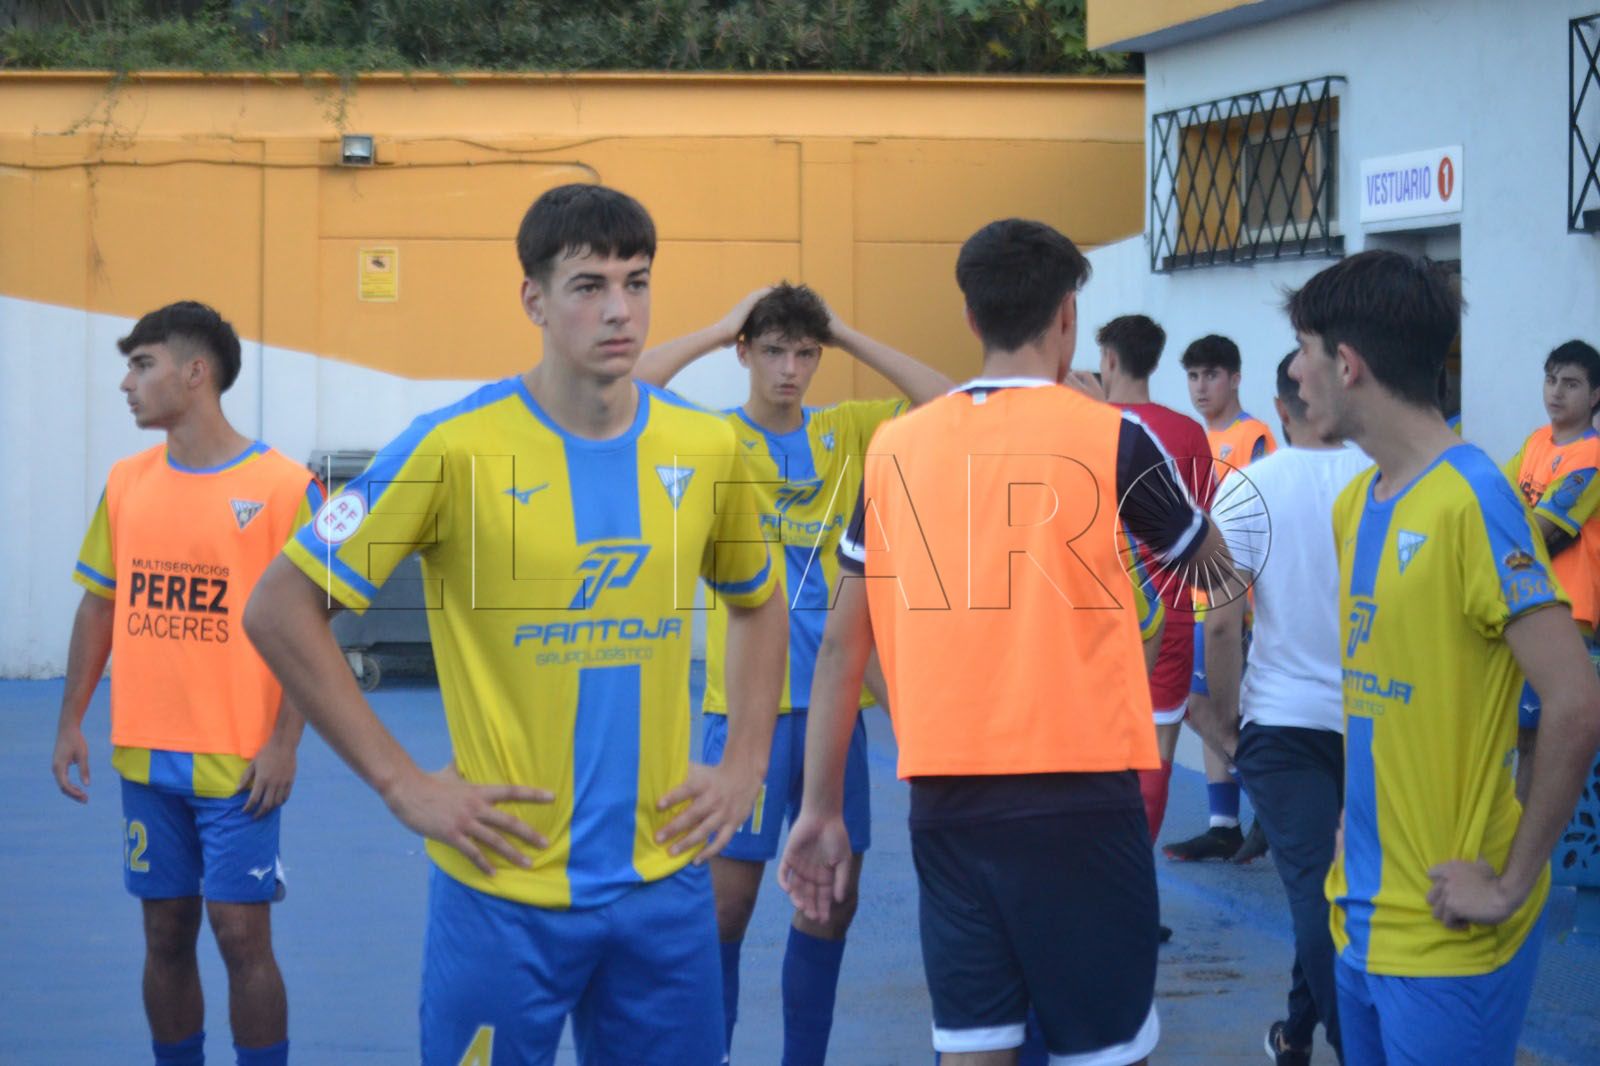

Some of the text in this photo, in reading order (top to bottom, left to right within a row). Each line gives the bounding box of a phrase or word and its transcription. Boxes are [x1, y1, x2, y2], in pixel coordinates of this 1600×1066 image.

[1366, 165, 1432, 206] VESTUARIO
[131, 557, 230, 577] MULTISERVICIOS
[130, 571, 229, 615] PEREZ
[127, 611, 230, 644] CACERES
[513, 617, 683, 647] PANTOJA
